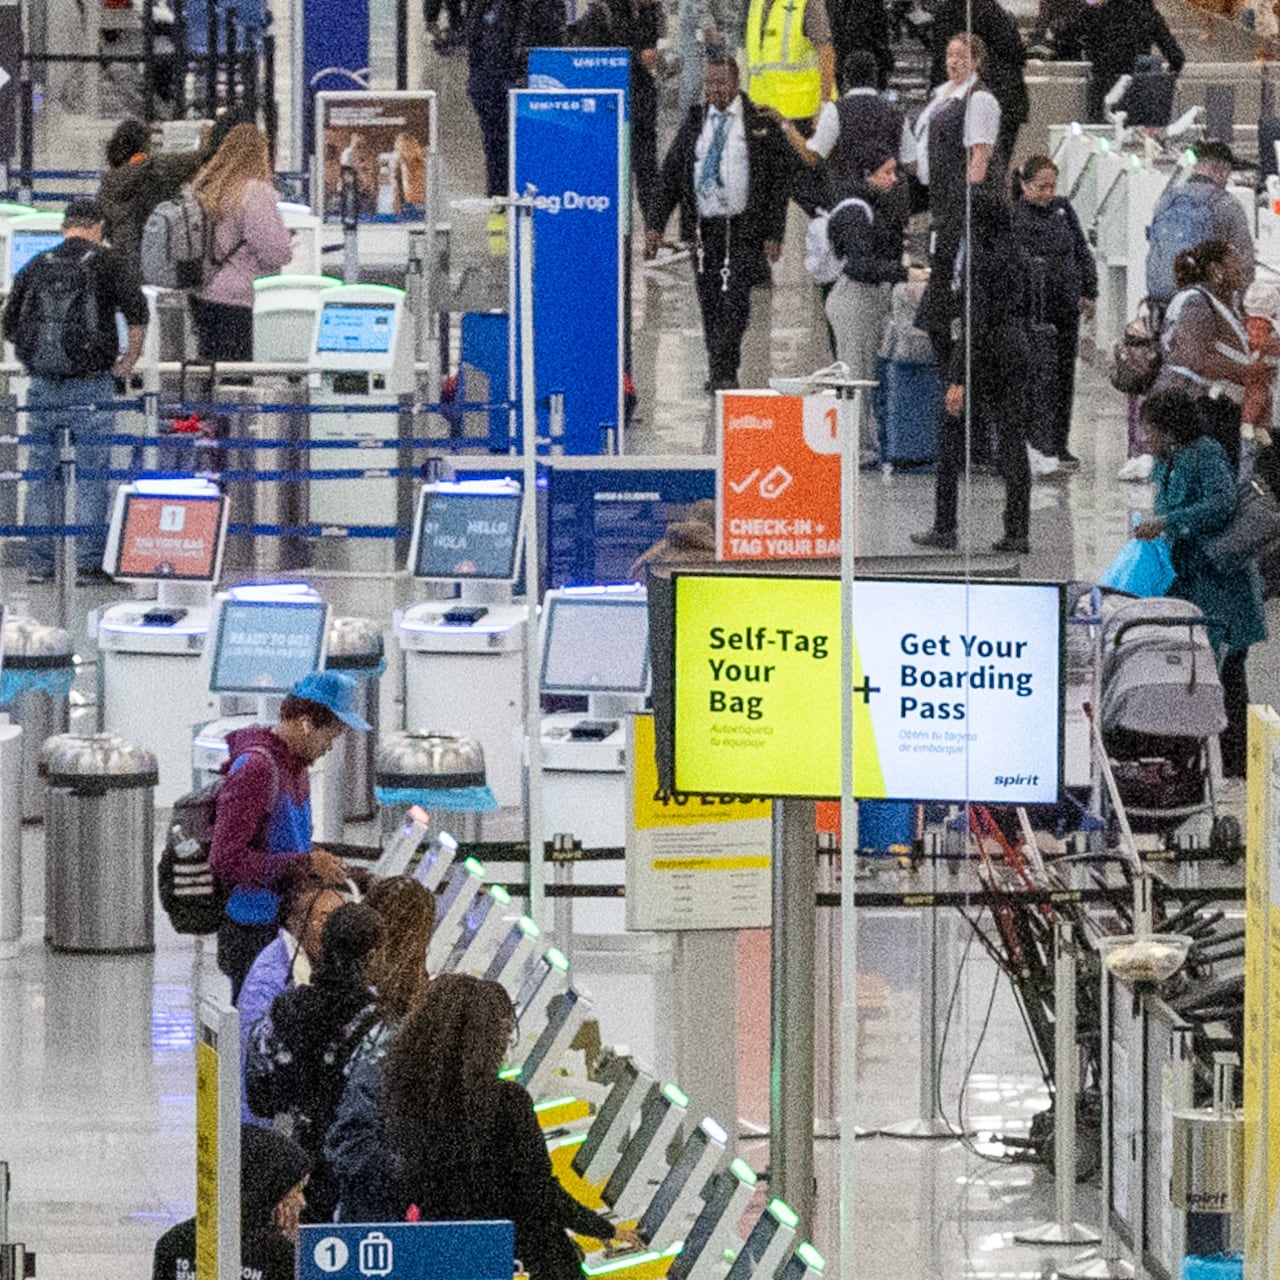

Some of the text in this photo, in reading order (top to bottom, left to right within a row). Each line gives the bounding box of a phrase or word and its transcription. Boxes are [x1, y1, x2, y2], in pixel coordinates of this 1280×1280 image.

[563, 191, 610, 210] Drop
[825, 408, 838, 438] 1
[730, 519, 812, 535] CHECK-IN
[730, 538, 762, 555] TAG
[766, 538, 812, 555] YOUR
[709, 626, 829, 659] Self-Tag
[900, 633, 1028, 658] Get Your
[708, 659, 776, 683] Your
[900, 664, 1034, 697] Boarding
[709, 690, 764, 720] Bag
[900, 697, 966, 720] Pass
[993, 773, 1040, 787] spirit
